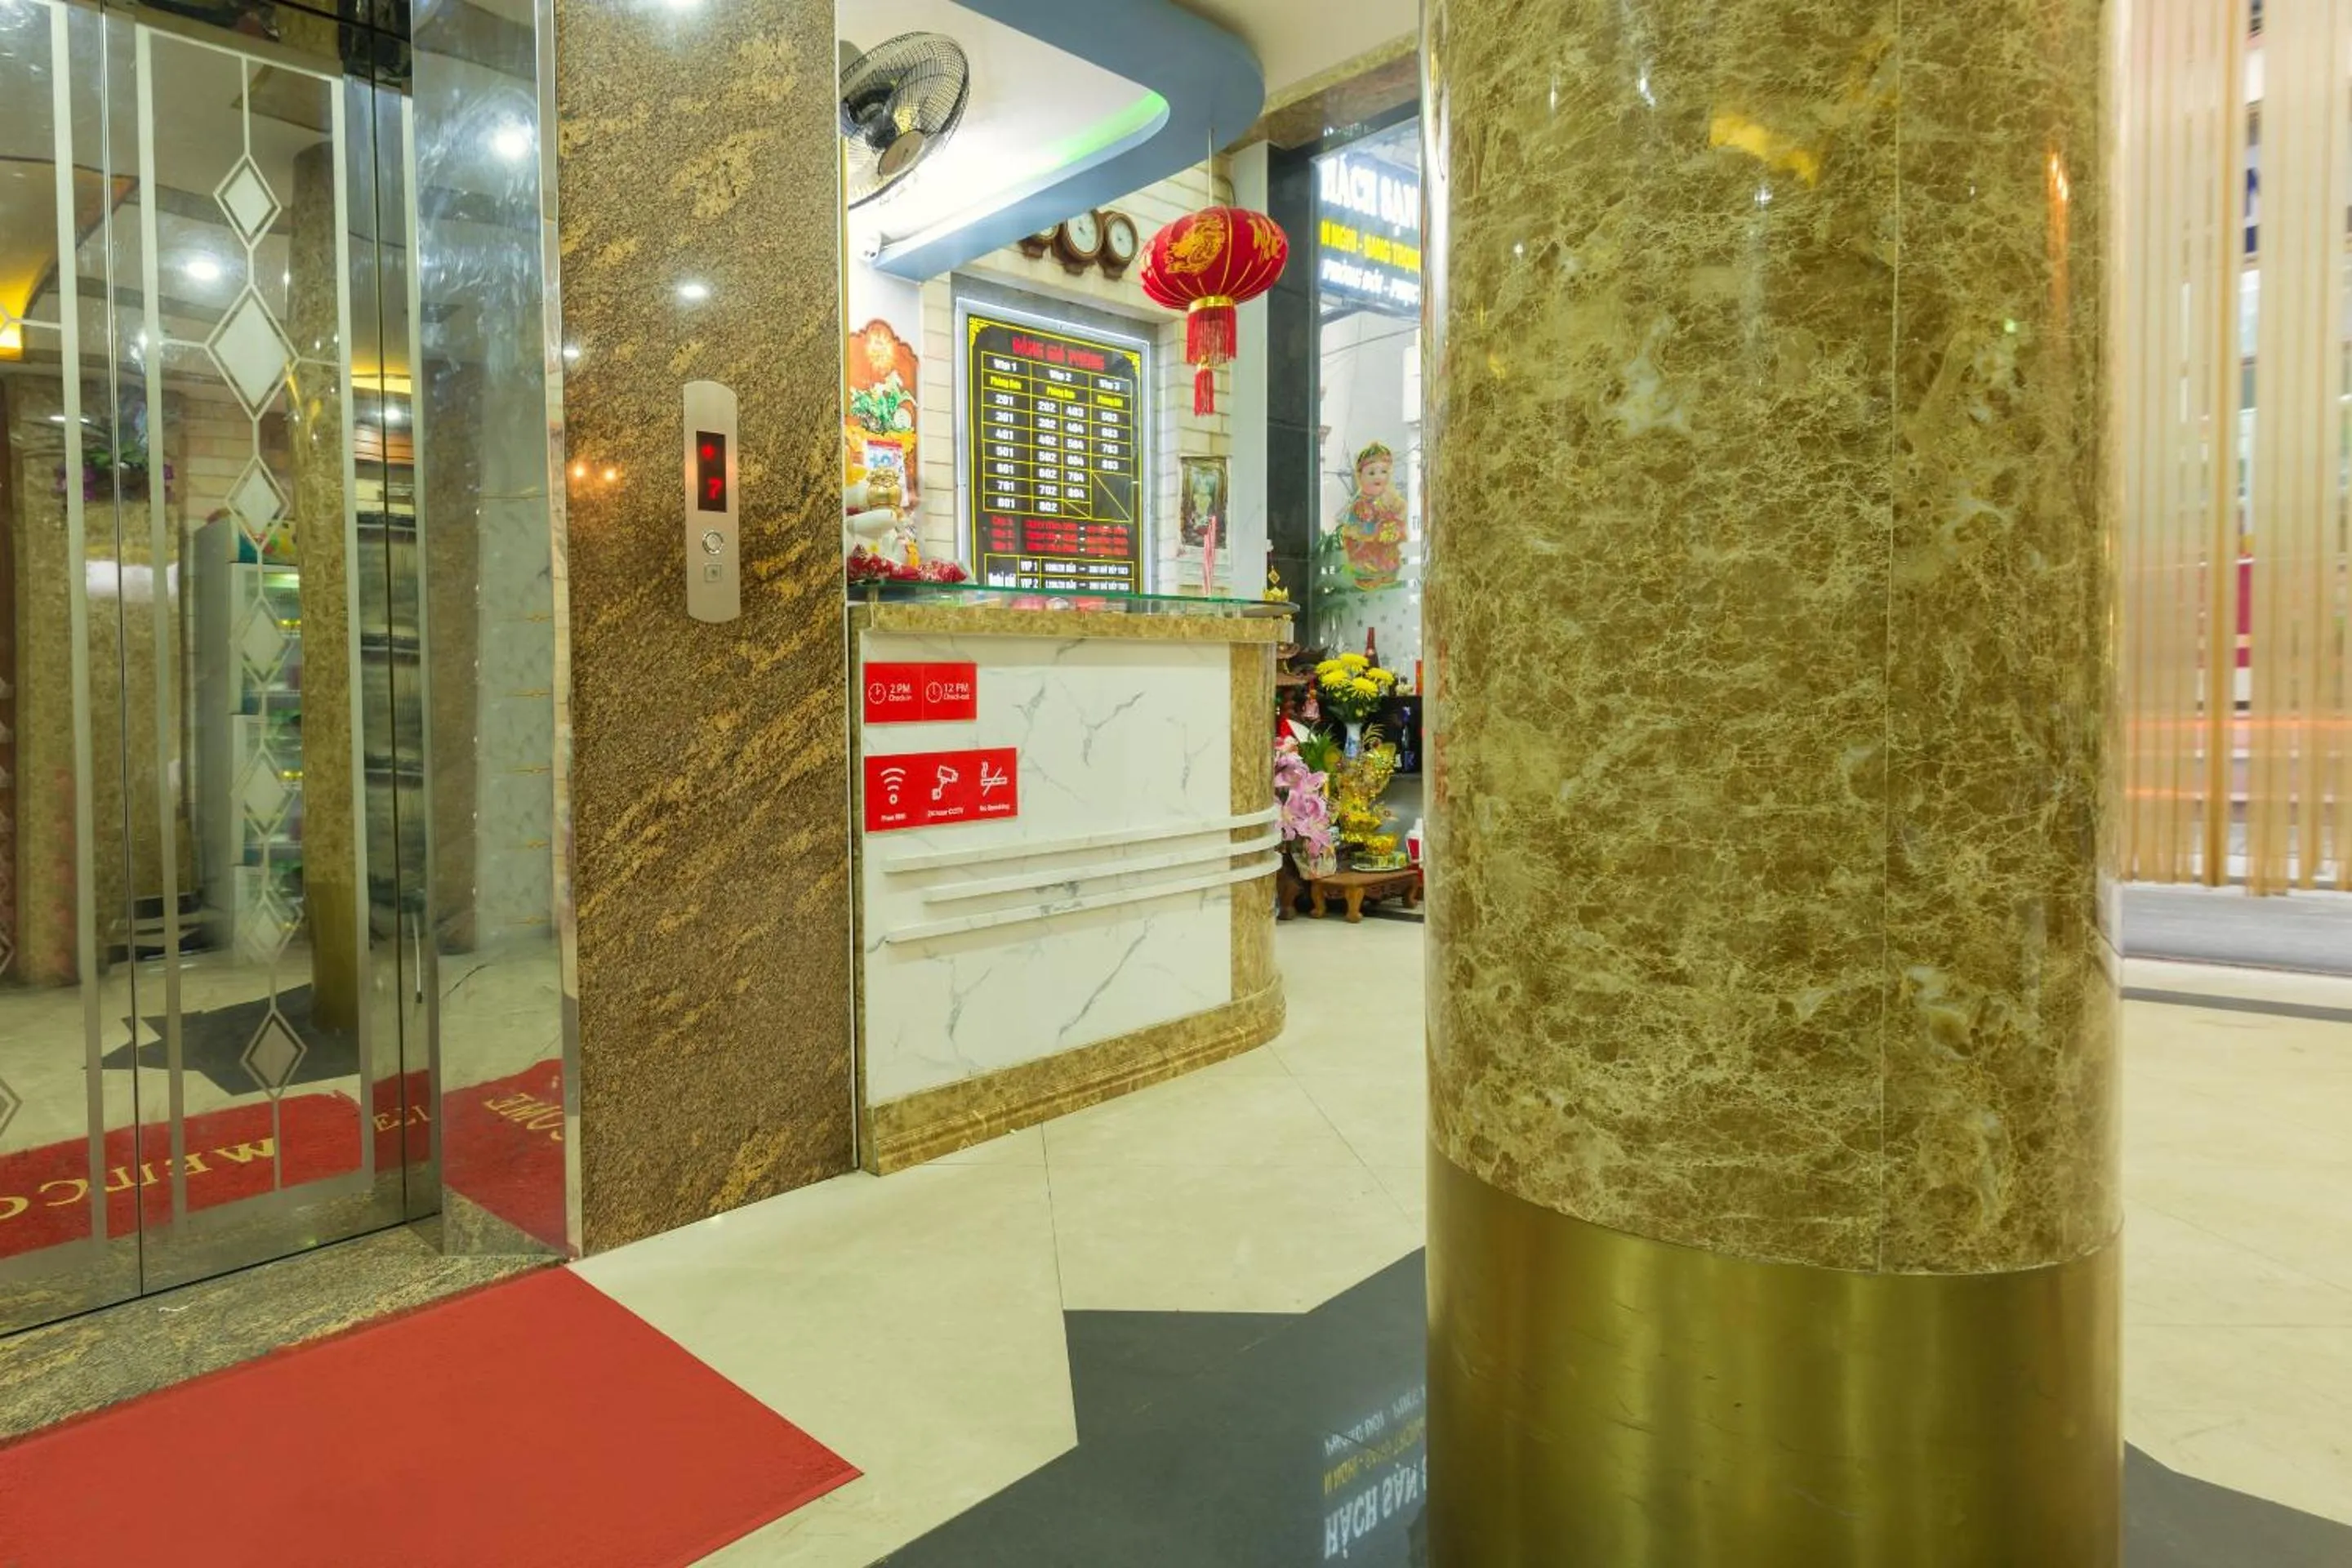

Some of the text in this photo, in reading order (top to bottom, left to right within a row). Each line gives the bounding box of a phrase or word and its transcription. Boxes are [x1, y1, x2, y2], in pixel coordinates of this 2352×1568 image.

[996, 394, 1013, 406] 201
[1037, 400, 1056, 412] 202
[996, 428, 1013, 440] 401
[1038, 451, 1057, 463] 502
[708, 478, 722, 500] 7
[997, 480, 1014, 492] 701
[1039, 484, 1058, 497] 702
[890, 683, 895, 693] 2
[944, 683, 954, 693] 12
